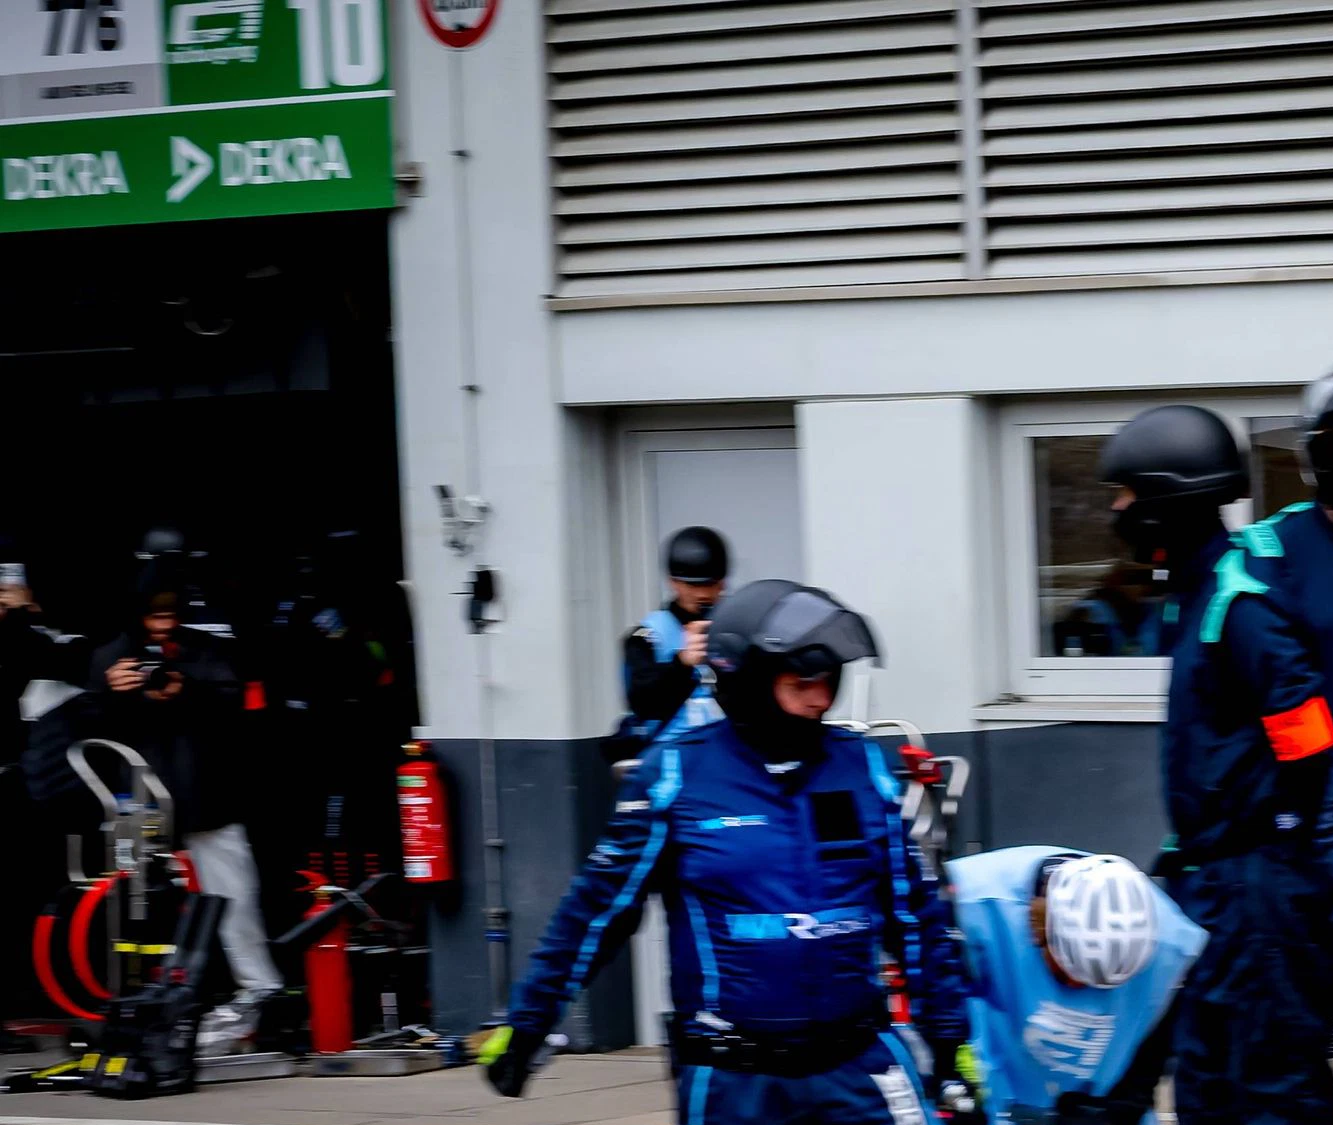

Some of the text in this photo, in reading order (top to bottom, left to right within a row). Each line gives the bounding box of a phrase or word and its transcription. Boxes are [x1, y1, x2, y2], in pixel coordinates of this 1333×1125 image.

[288, 0, 386, 90] 10
[2, 151, 130, 200] DEKRA
[219, 135, 352, 187] DEKRA
